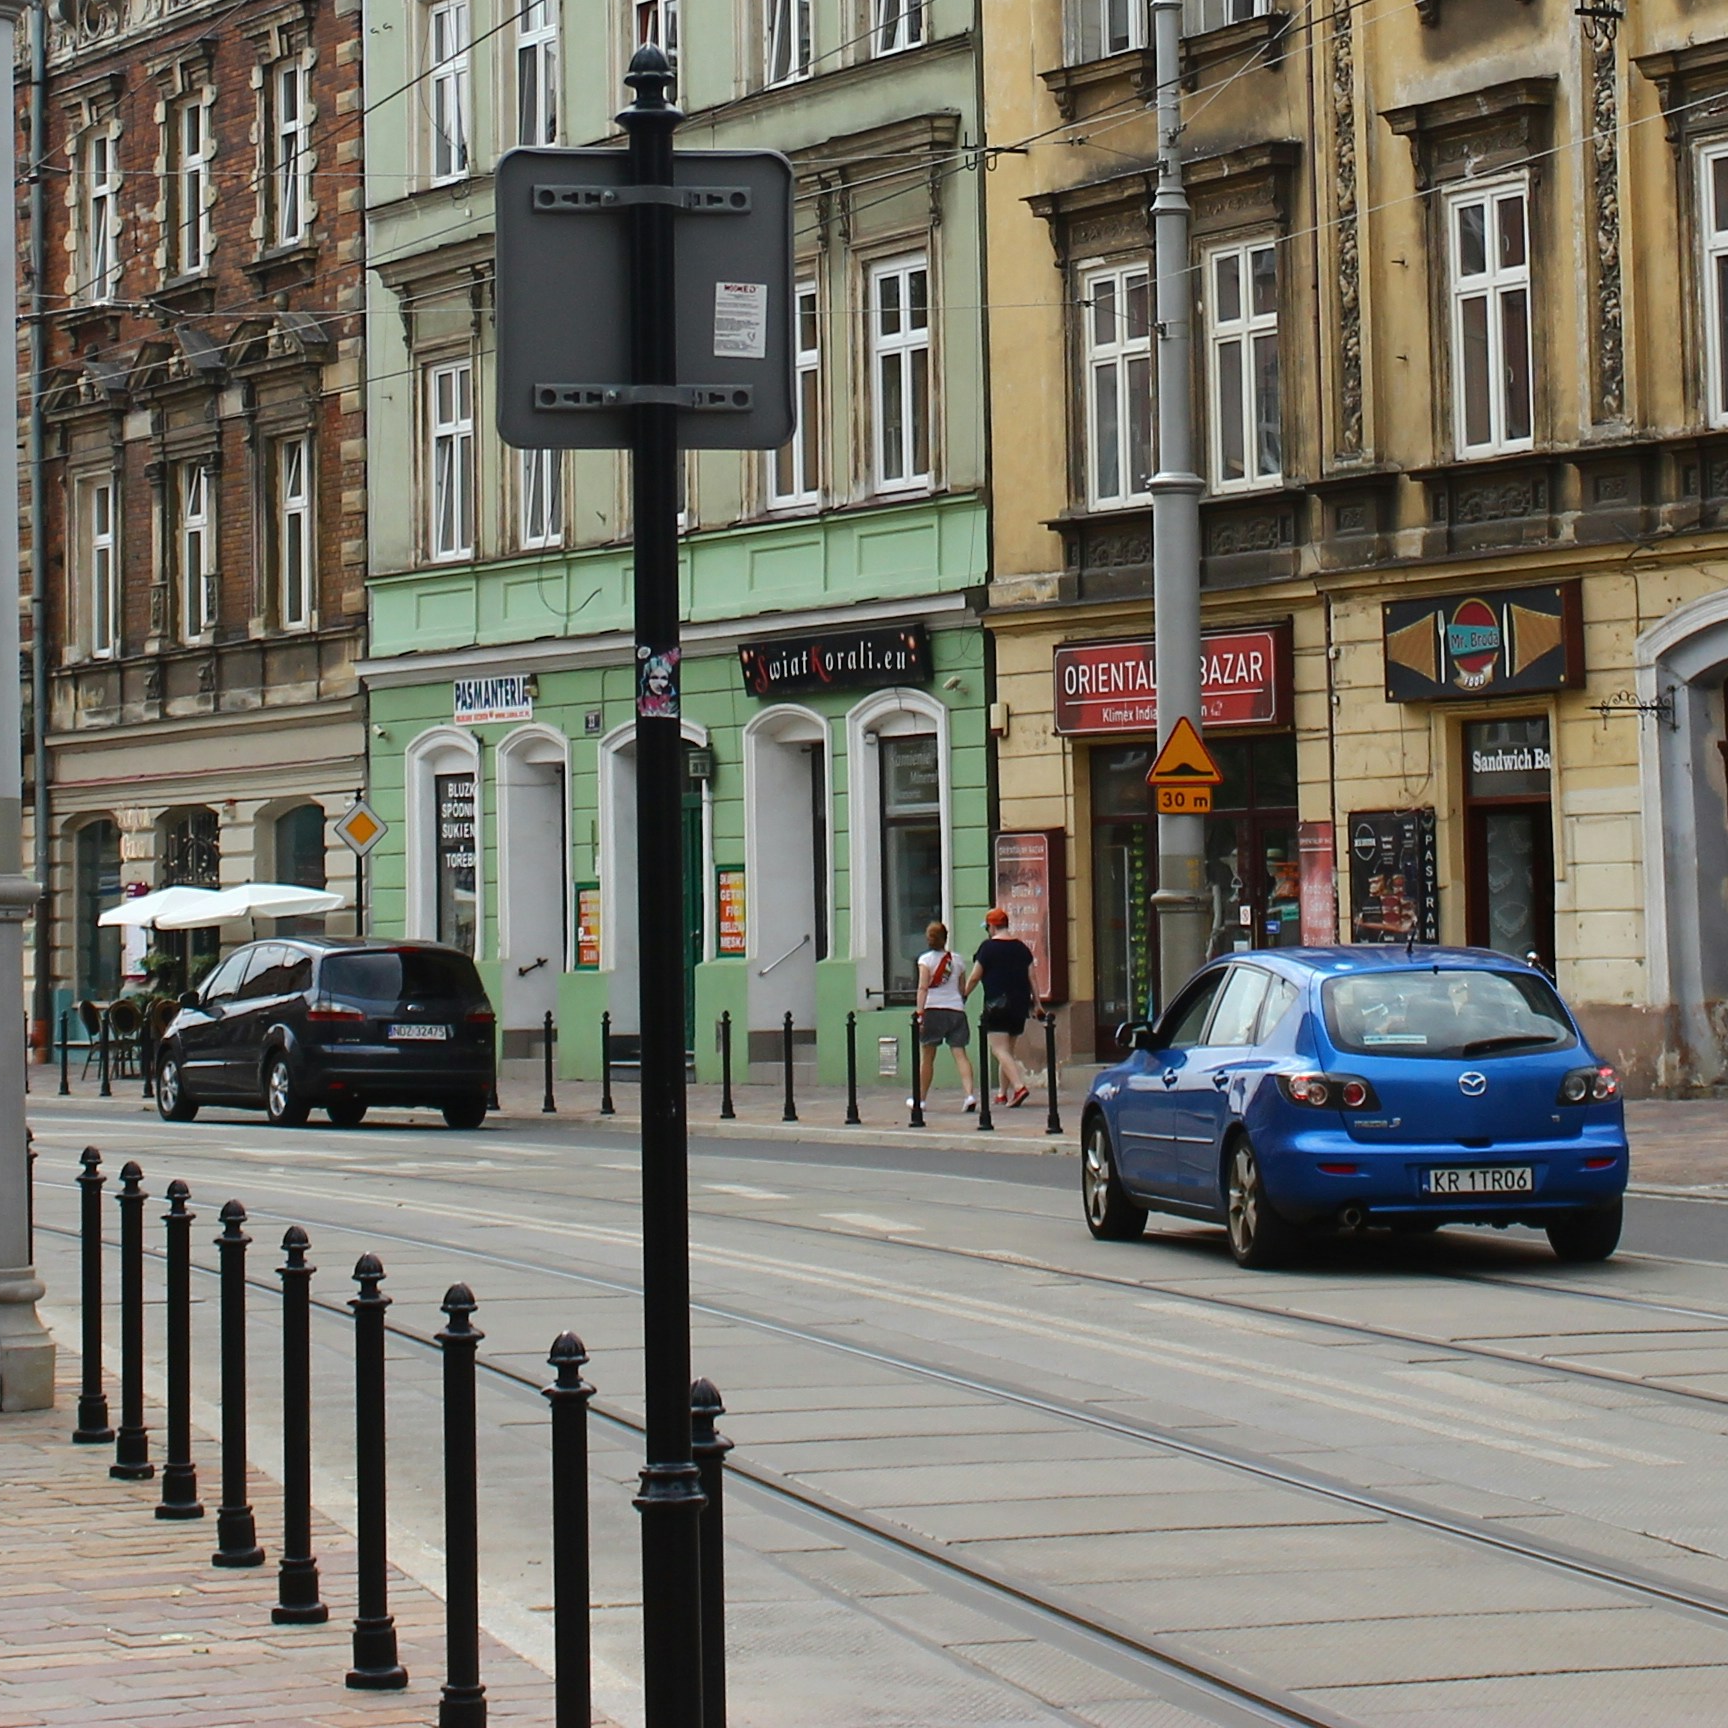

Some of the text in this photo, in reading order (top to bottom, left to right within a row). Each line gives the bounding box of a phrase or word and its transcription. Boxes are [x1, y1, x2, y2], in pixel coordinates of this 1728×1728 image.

[1451, 634, 1468, 649] Mr.
[1463, 673, 1486, 687] FOOD
[454, 676, 530, 712] PASMANTERIA
[1102, 702, 1134, 722] Klimex
[1472, 747, 1551, 773] Sandwich Ba
[1162, 791, 1209, 808] 30 m
[1434, 1169, 1528, 1193] KR 1TR06
